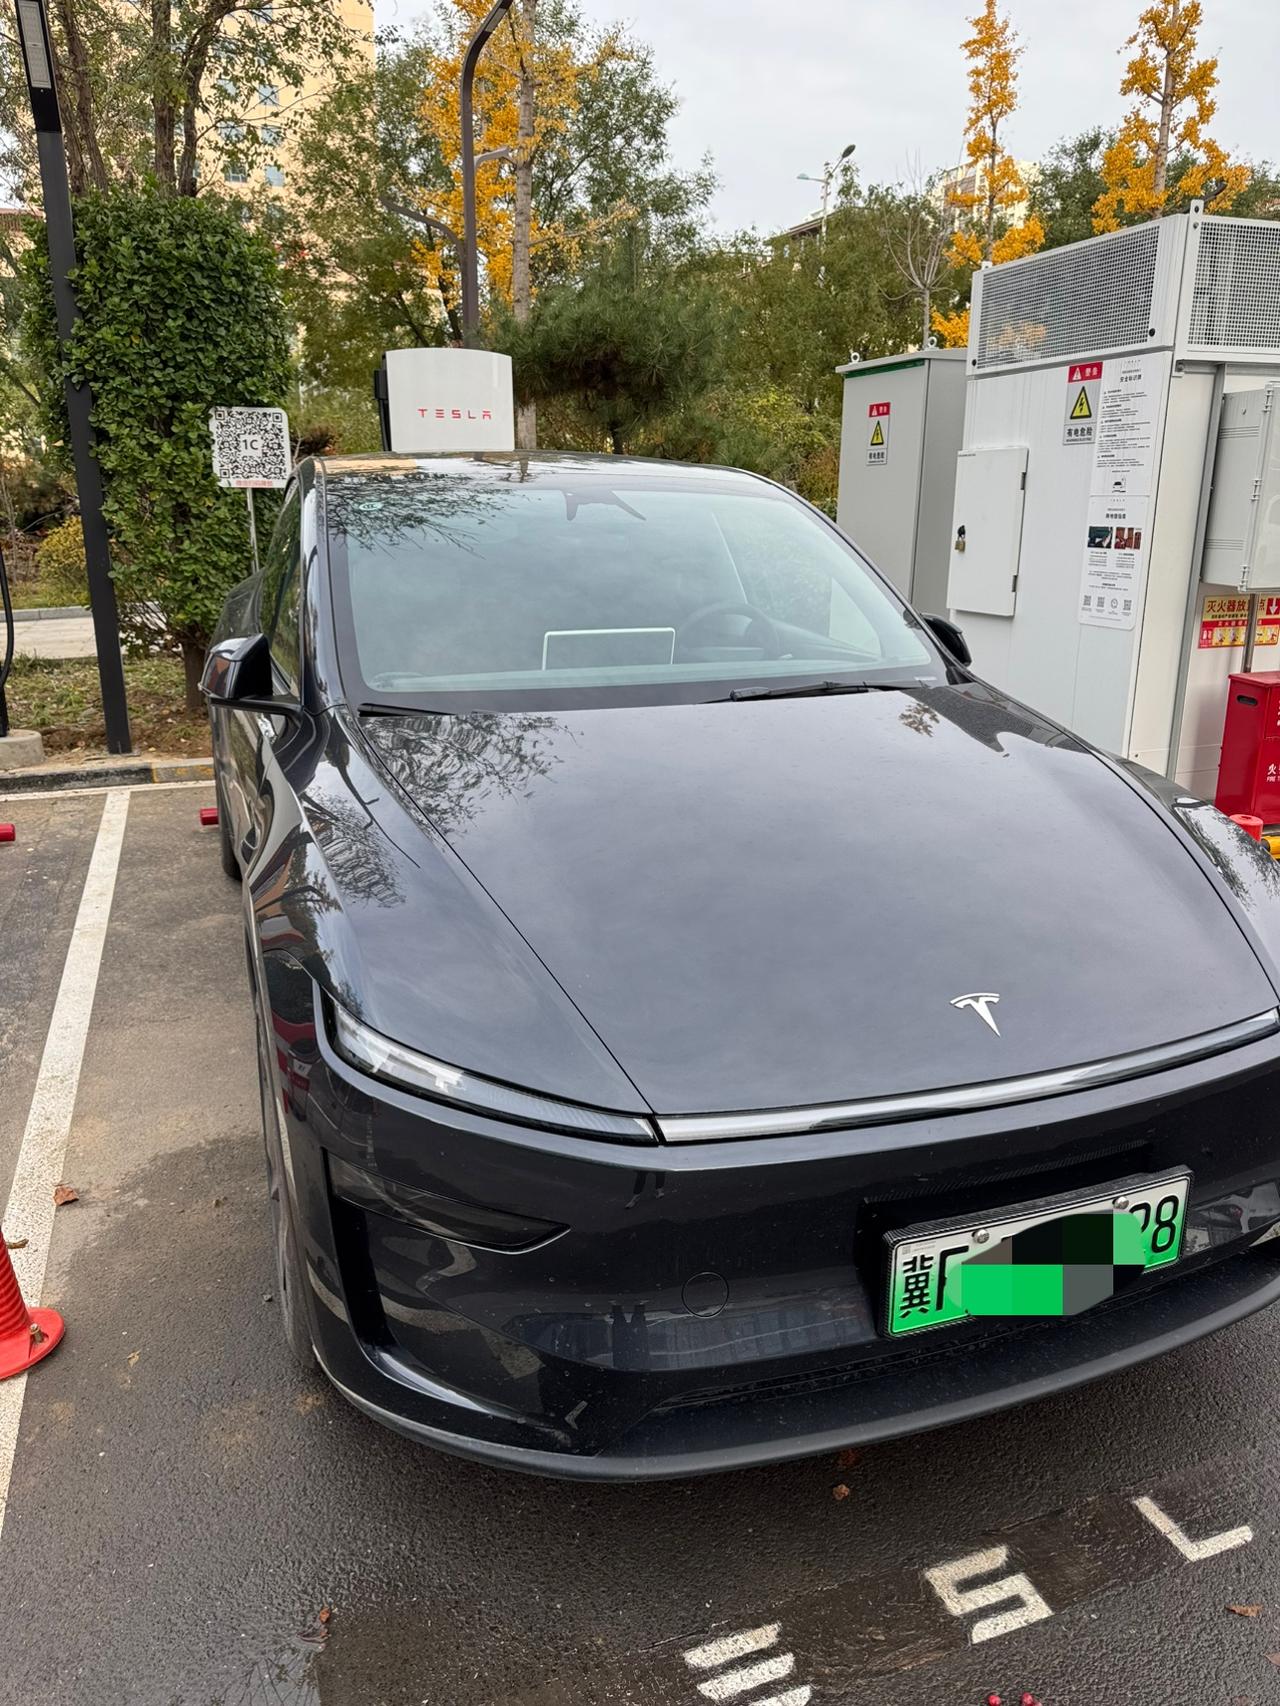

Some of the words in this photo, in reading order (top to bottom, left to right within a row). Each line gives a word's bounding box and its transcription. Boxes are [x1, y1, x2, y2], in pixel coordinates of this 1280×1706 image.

[417, 408, 492, 420] TESLA
[1067, 427, 1093, 437] 有电危险
[242, 438, 258, 450] 1C
[1206, 598, 1266, 613] 灭火器放点
